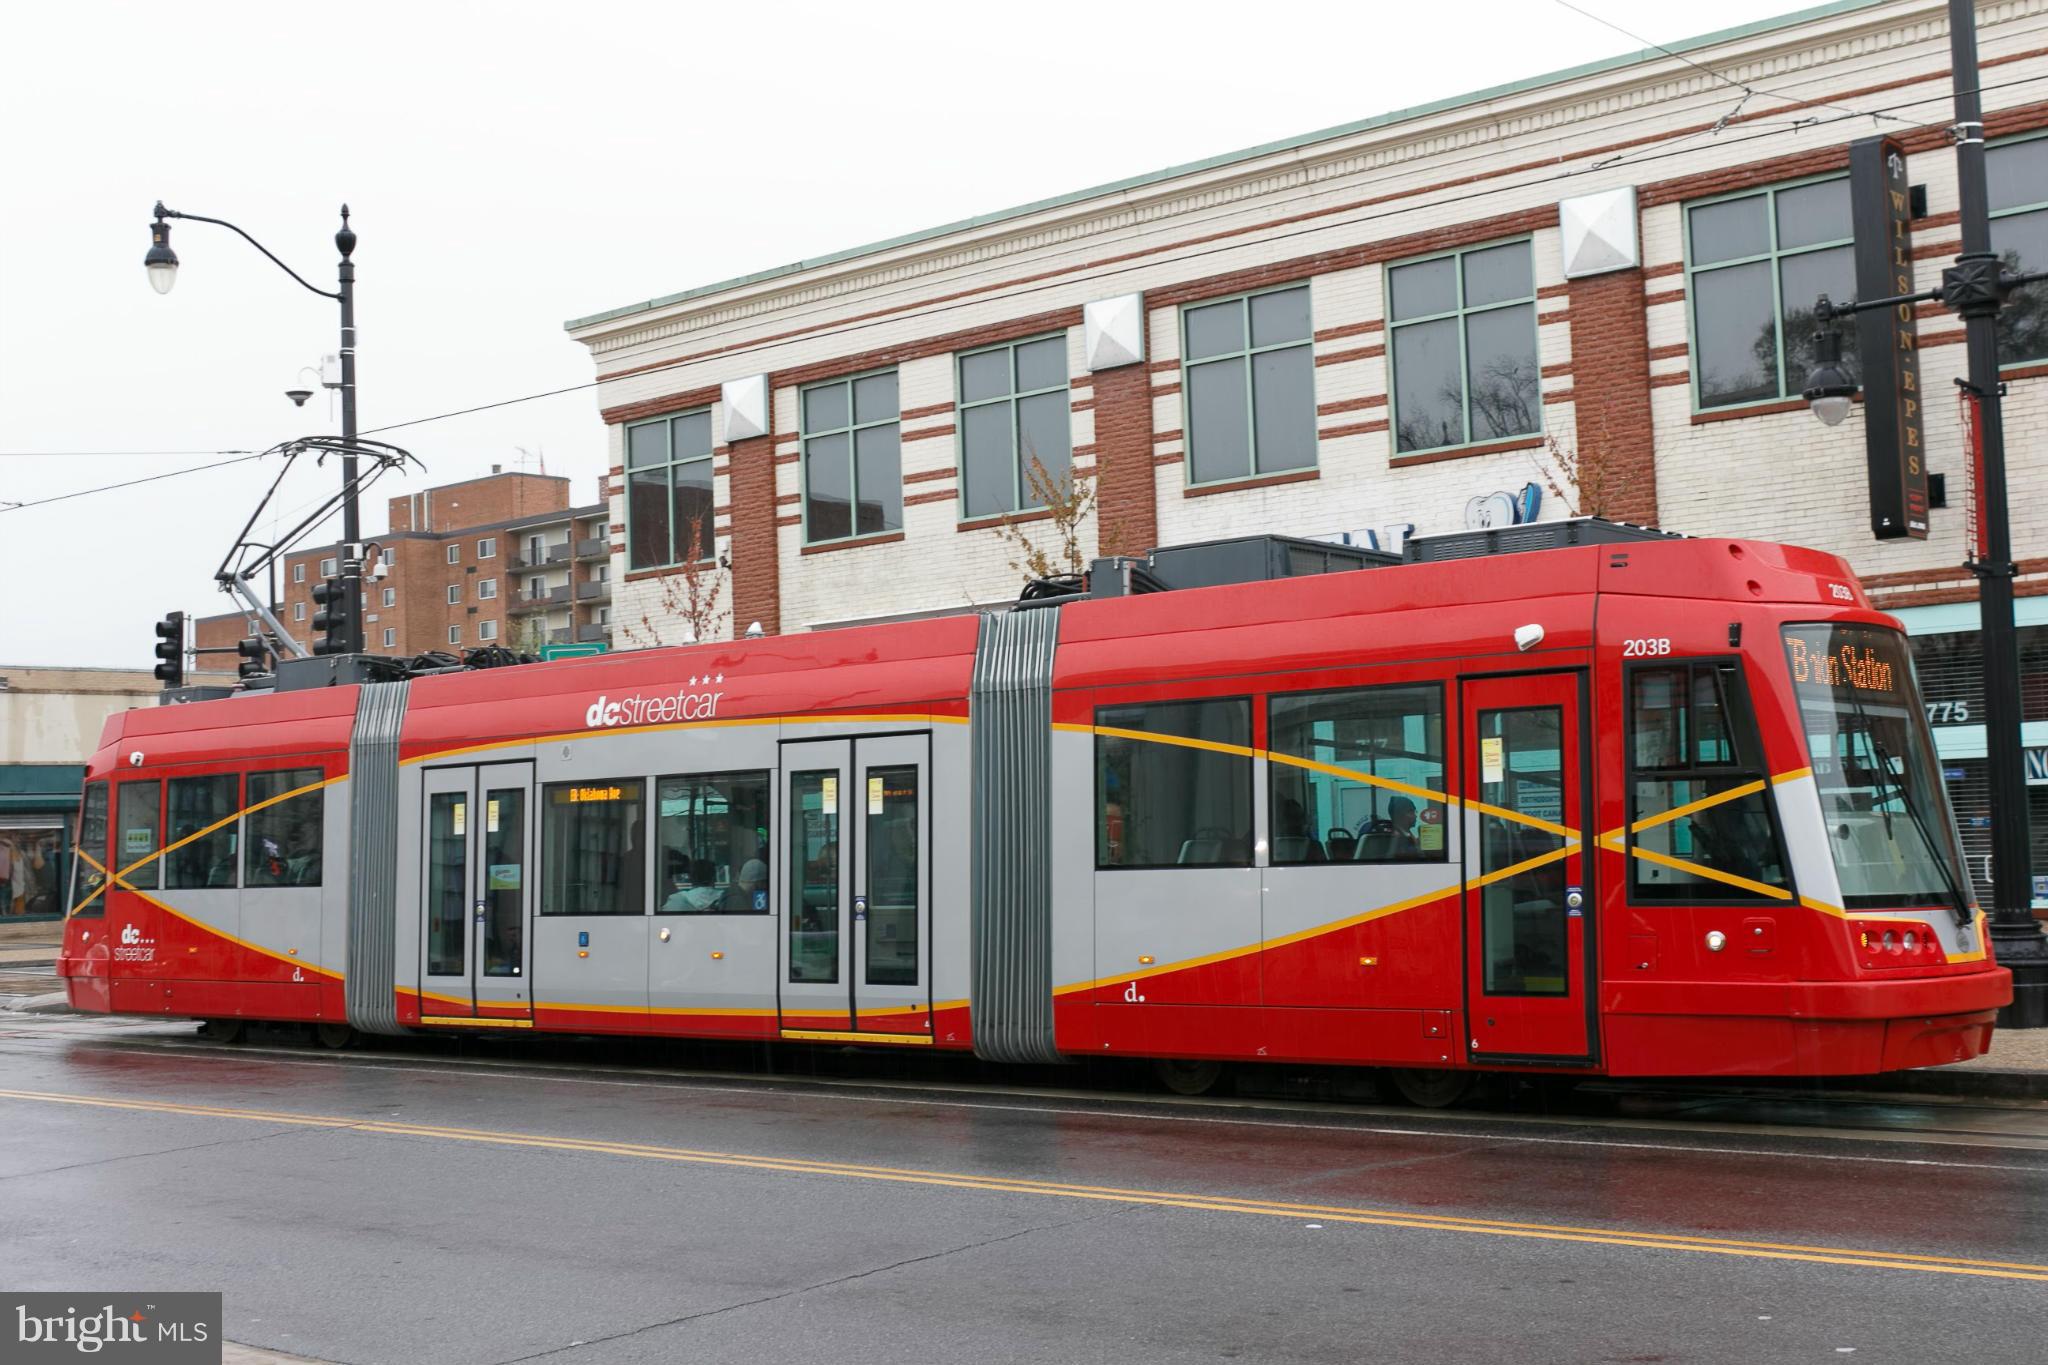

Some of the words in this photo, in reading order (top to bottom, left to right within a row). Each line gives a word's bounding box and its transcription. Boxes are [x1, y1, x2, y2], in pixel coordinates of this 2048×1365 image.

[1623, 638, 1671, 657] 203B
[1841, 645, 1892, 691] Station
[114, 945, 155, 961] streetcar
[1471, 1038, 1479, 1049] 6
